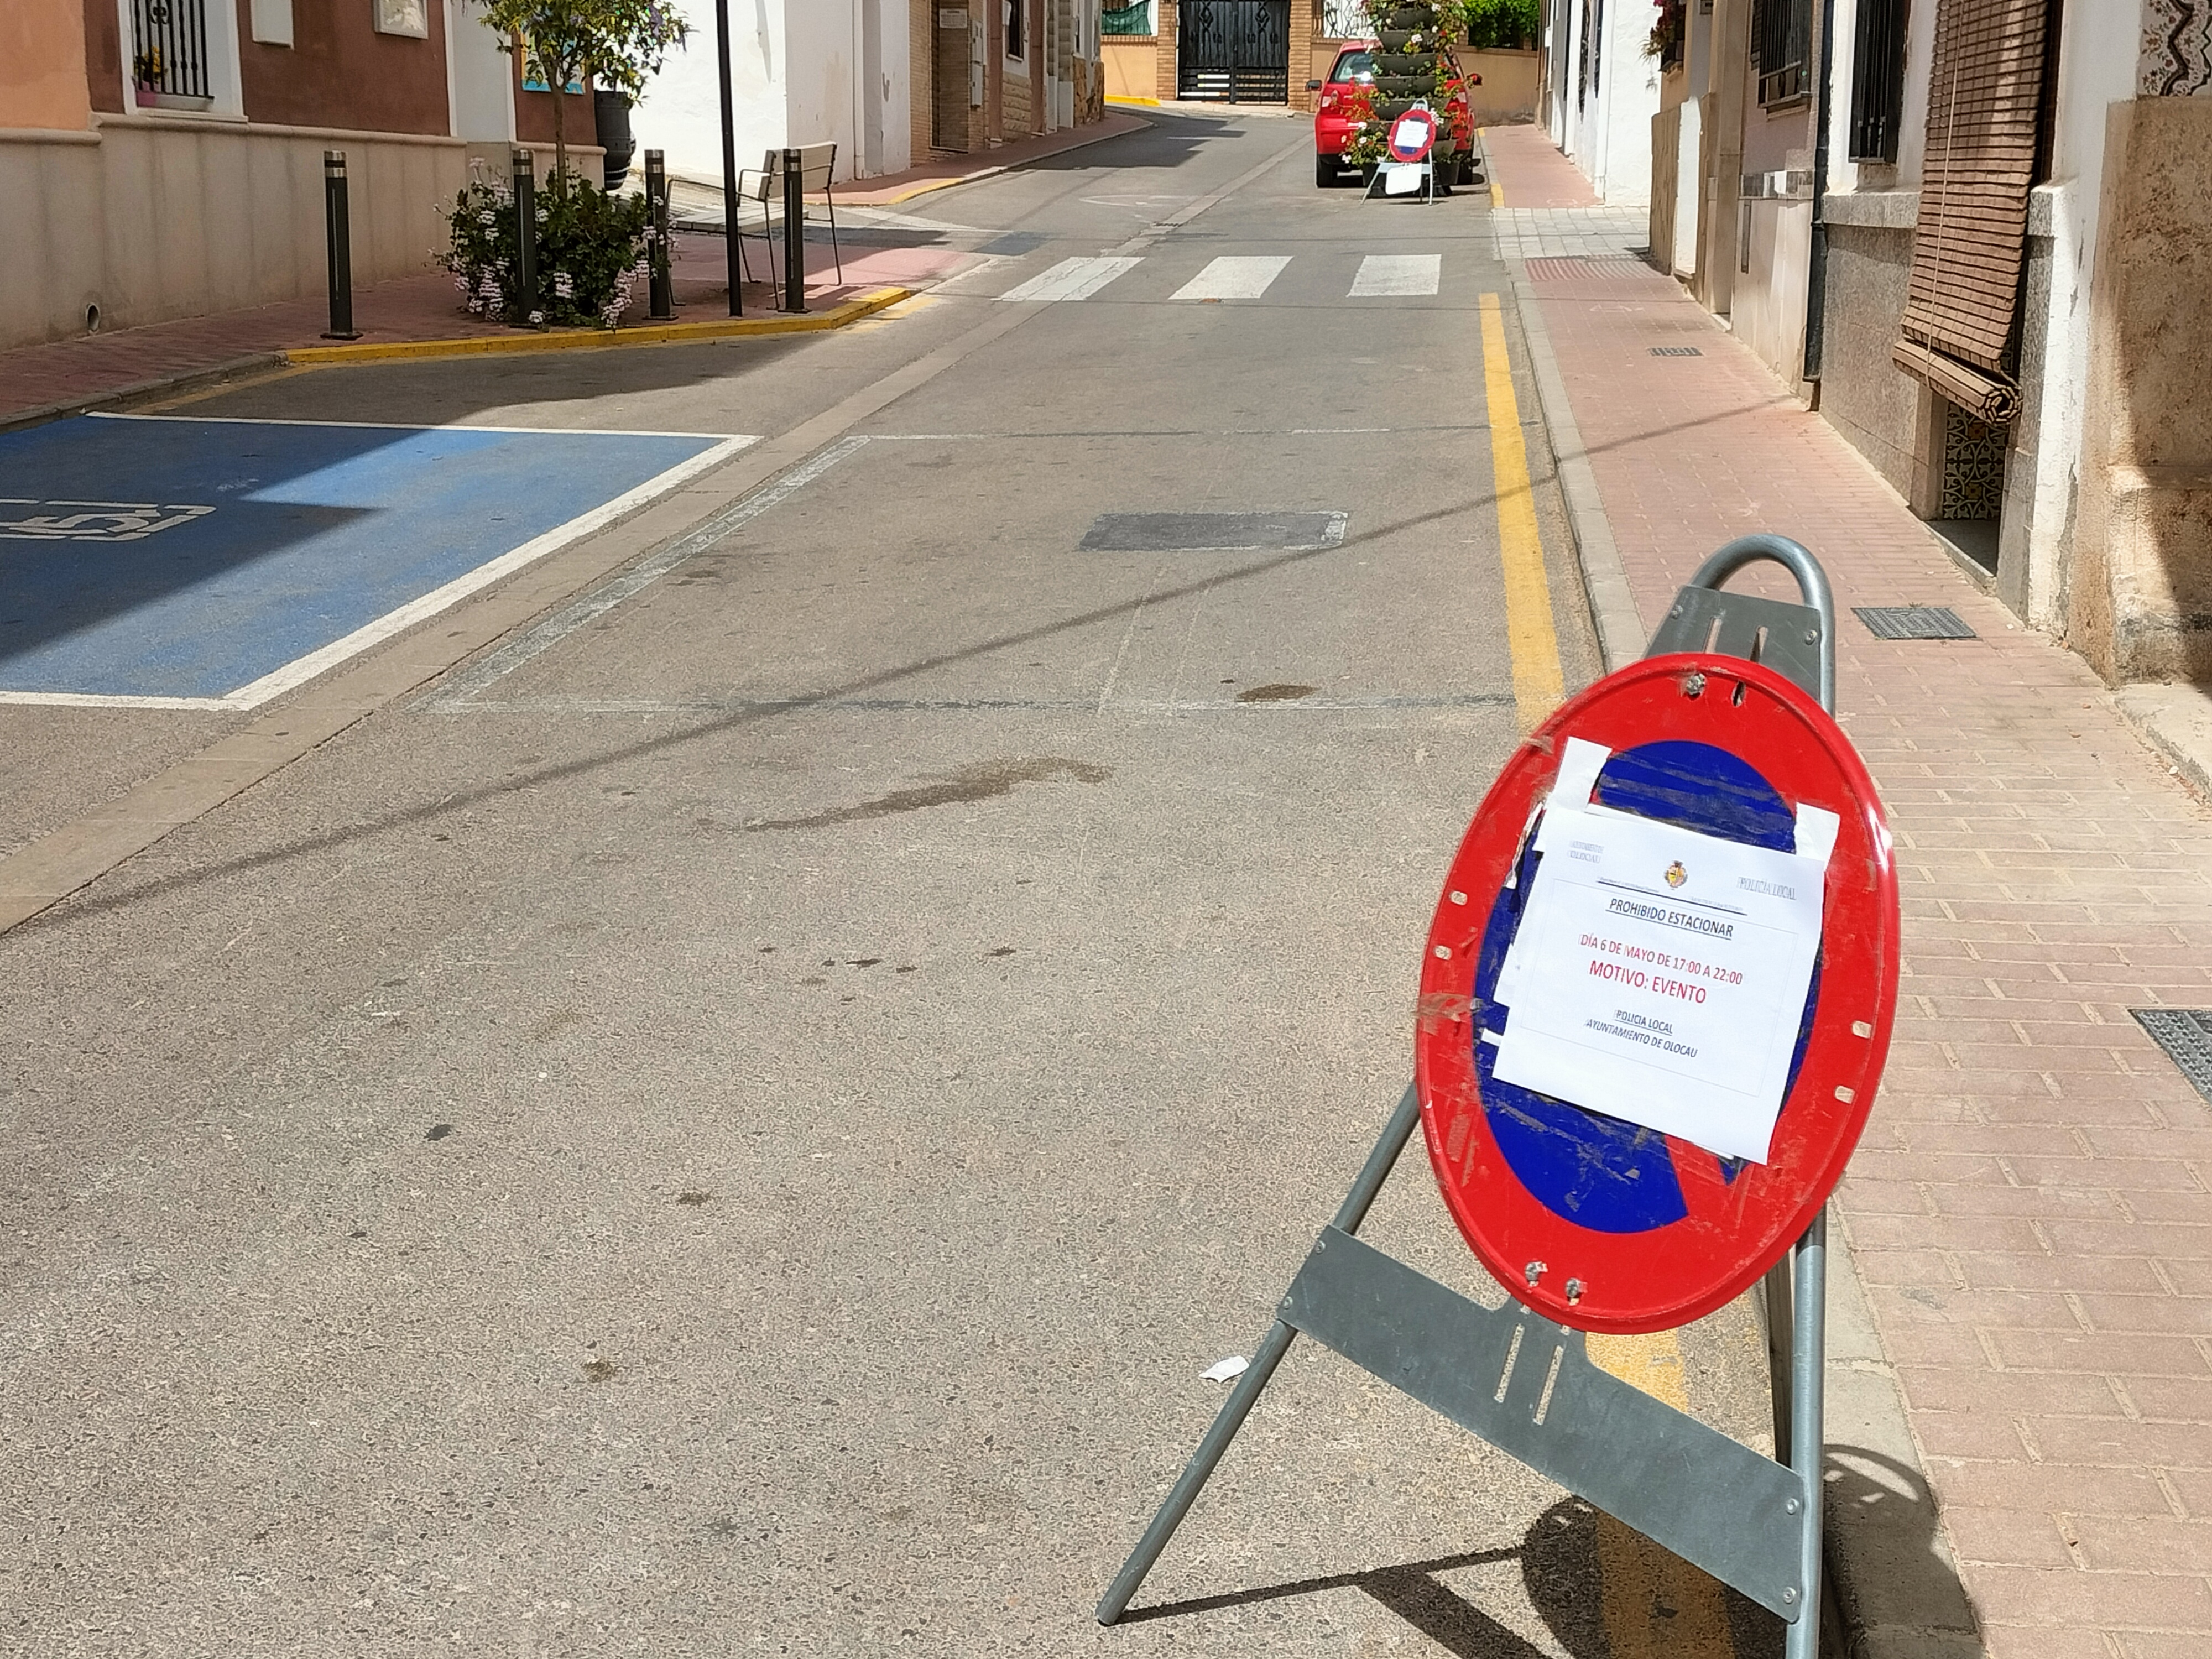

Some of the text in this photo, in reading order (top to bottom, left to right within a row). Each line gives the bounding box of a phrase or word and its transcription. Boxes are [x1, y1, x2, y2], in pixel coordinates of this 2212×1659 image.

[1609, 898, 1666, 921] PROHIBIDO
[1668, 912, 1734, 937] ESTACIONAR
[1580, 933, 1743, 985] DÍA 6 DE MAYO DE 17:00 A 22:00
[1589, 960, 1707, 1004] MOTIVO: EVENTO
[1584, 1019, 1698, 1058] AYUNTAMIENTO DE OLOCAU
[1614, 1009, 1673, 1034] POLICIA LOCAL
